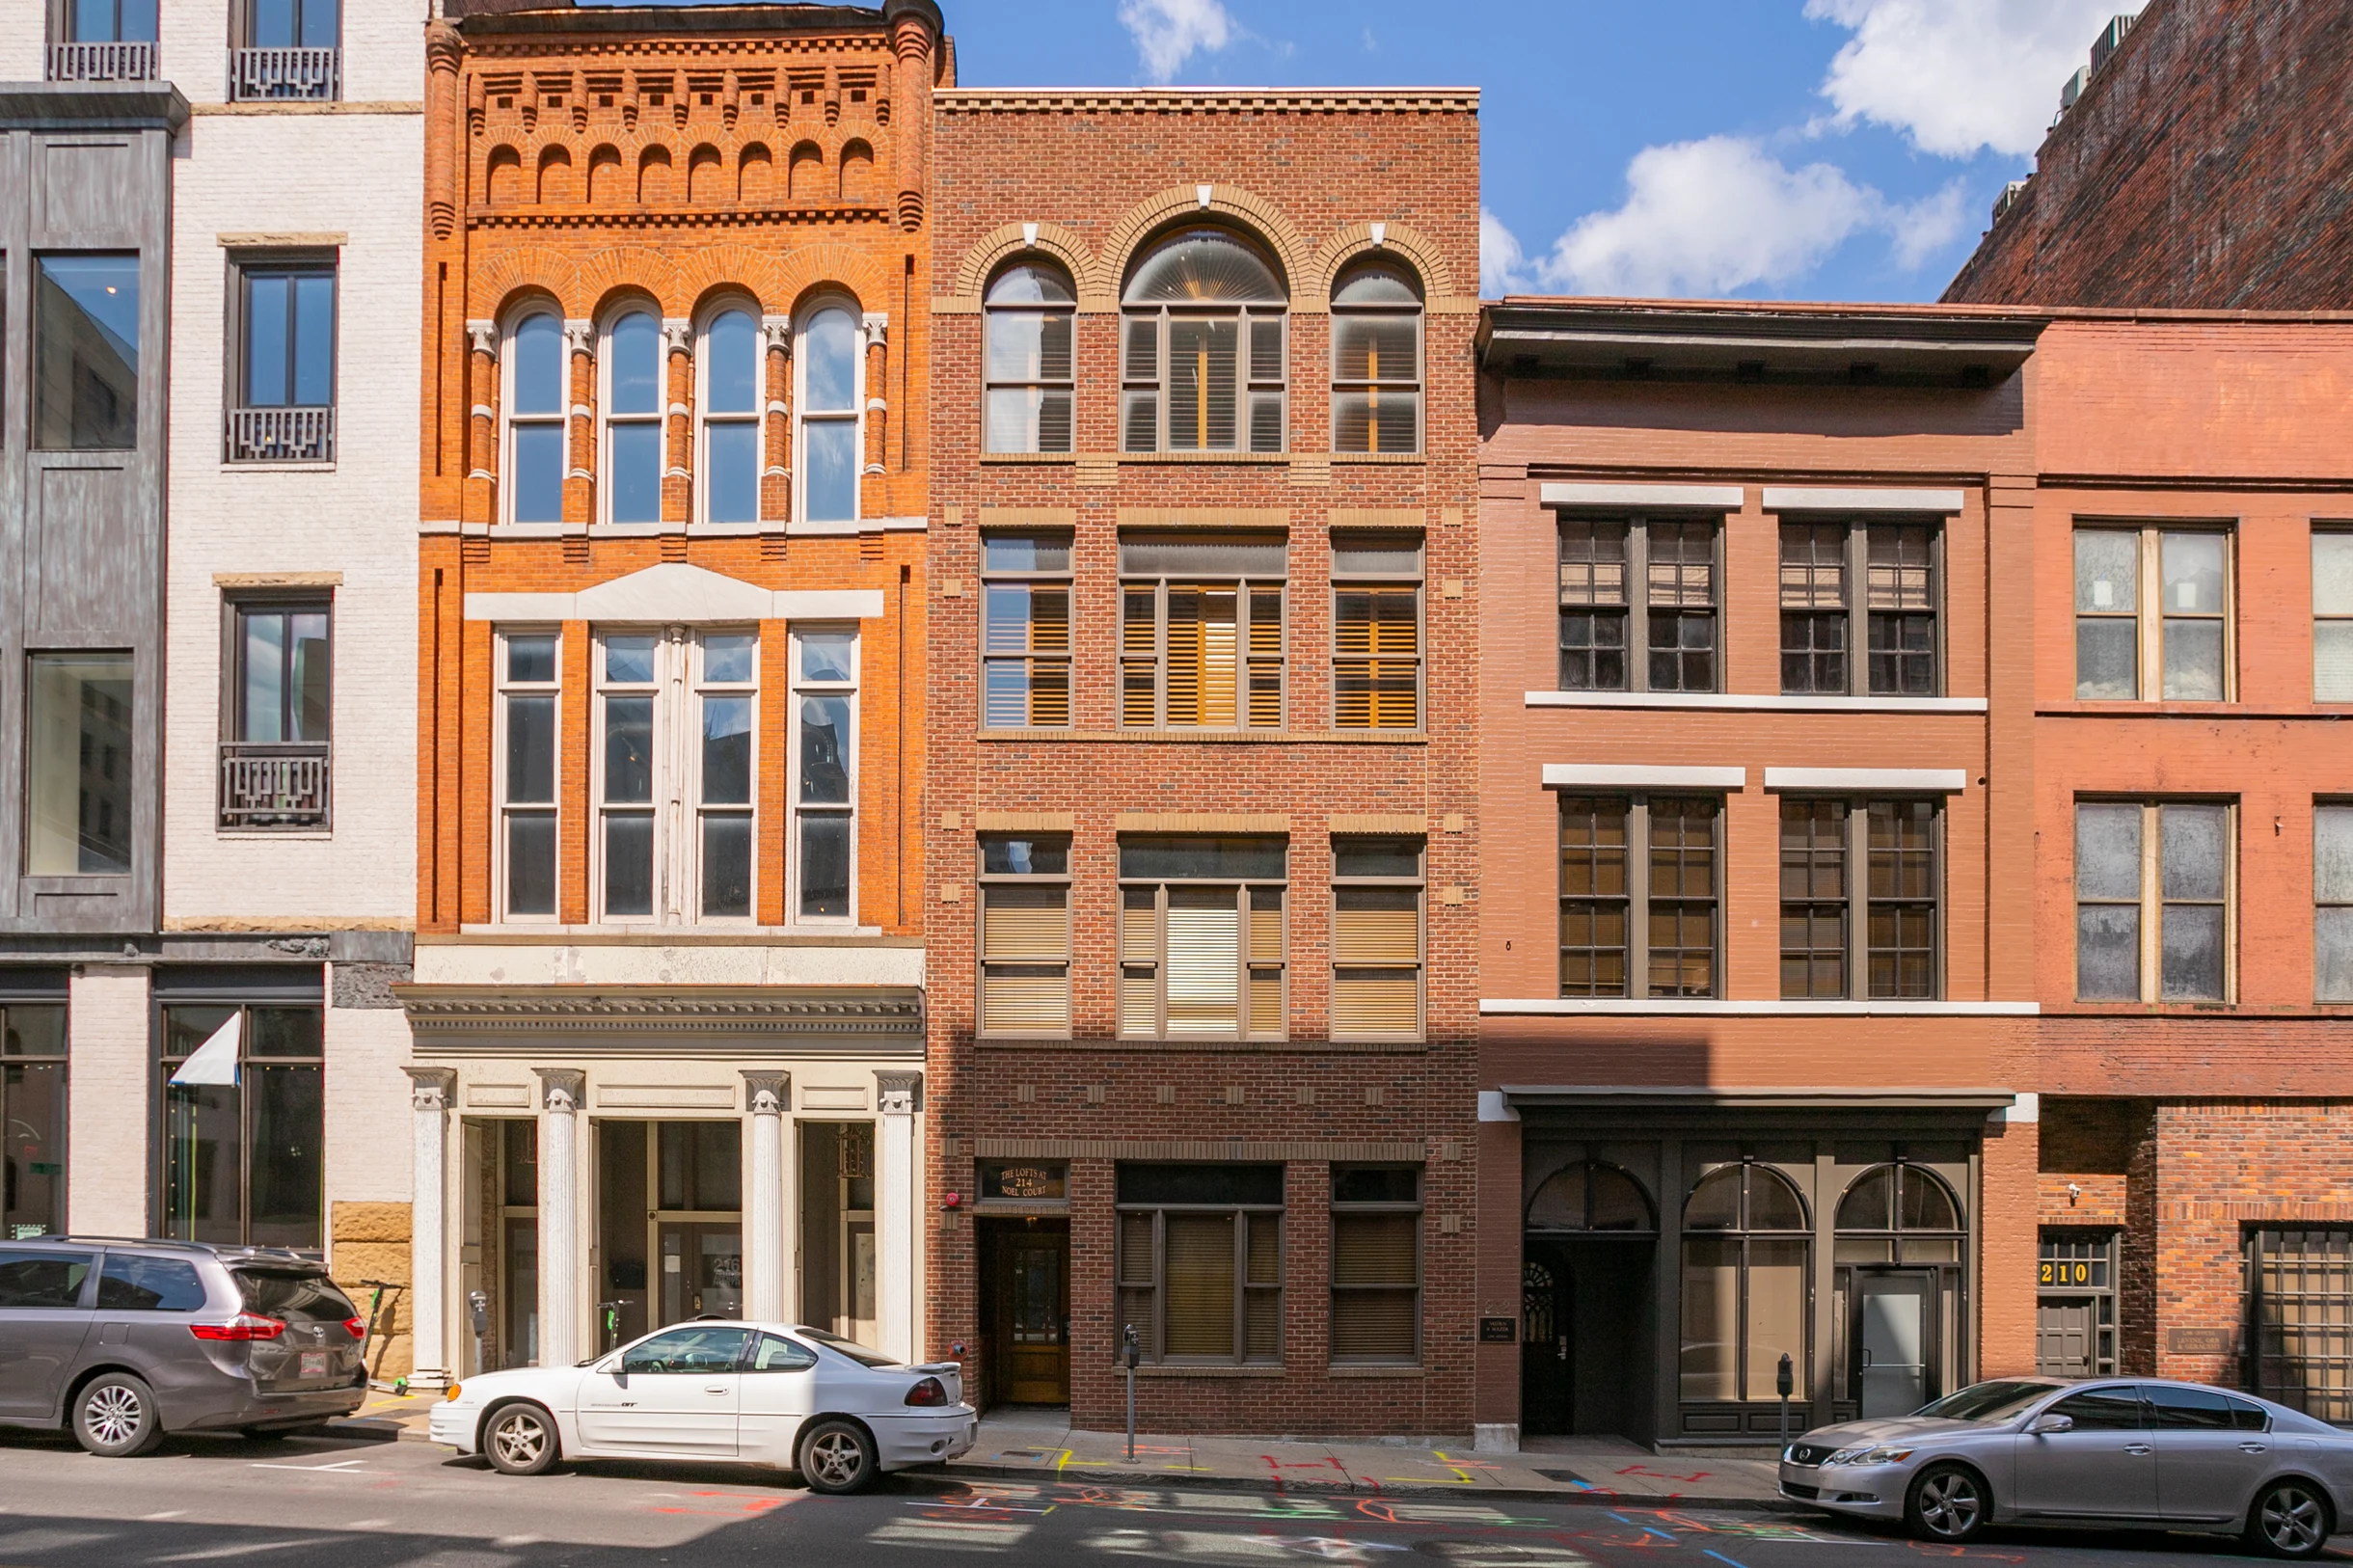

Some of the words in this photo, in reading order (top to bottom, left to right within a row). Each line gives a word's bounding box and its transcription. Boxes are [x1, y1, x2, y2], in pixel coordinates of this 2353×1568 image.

[1001, 1169, 1014, 1180] THE
[1015, 1168, 1038, 1177] LOFTS
[1039, 1171, 1047, 1180] AT
[1015, 1177, 1033, 1187] 214
[1002, 1185, 1019, 1197] NOEL
[1022, 1185, 1046, 1197] COURT
[2041, 1263, 2087, 1283] 210
